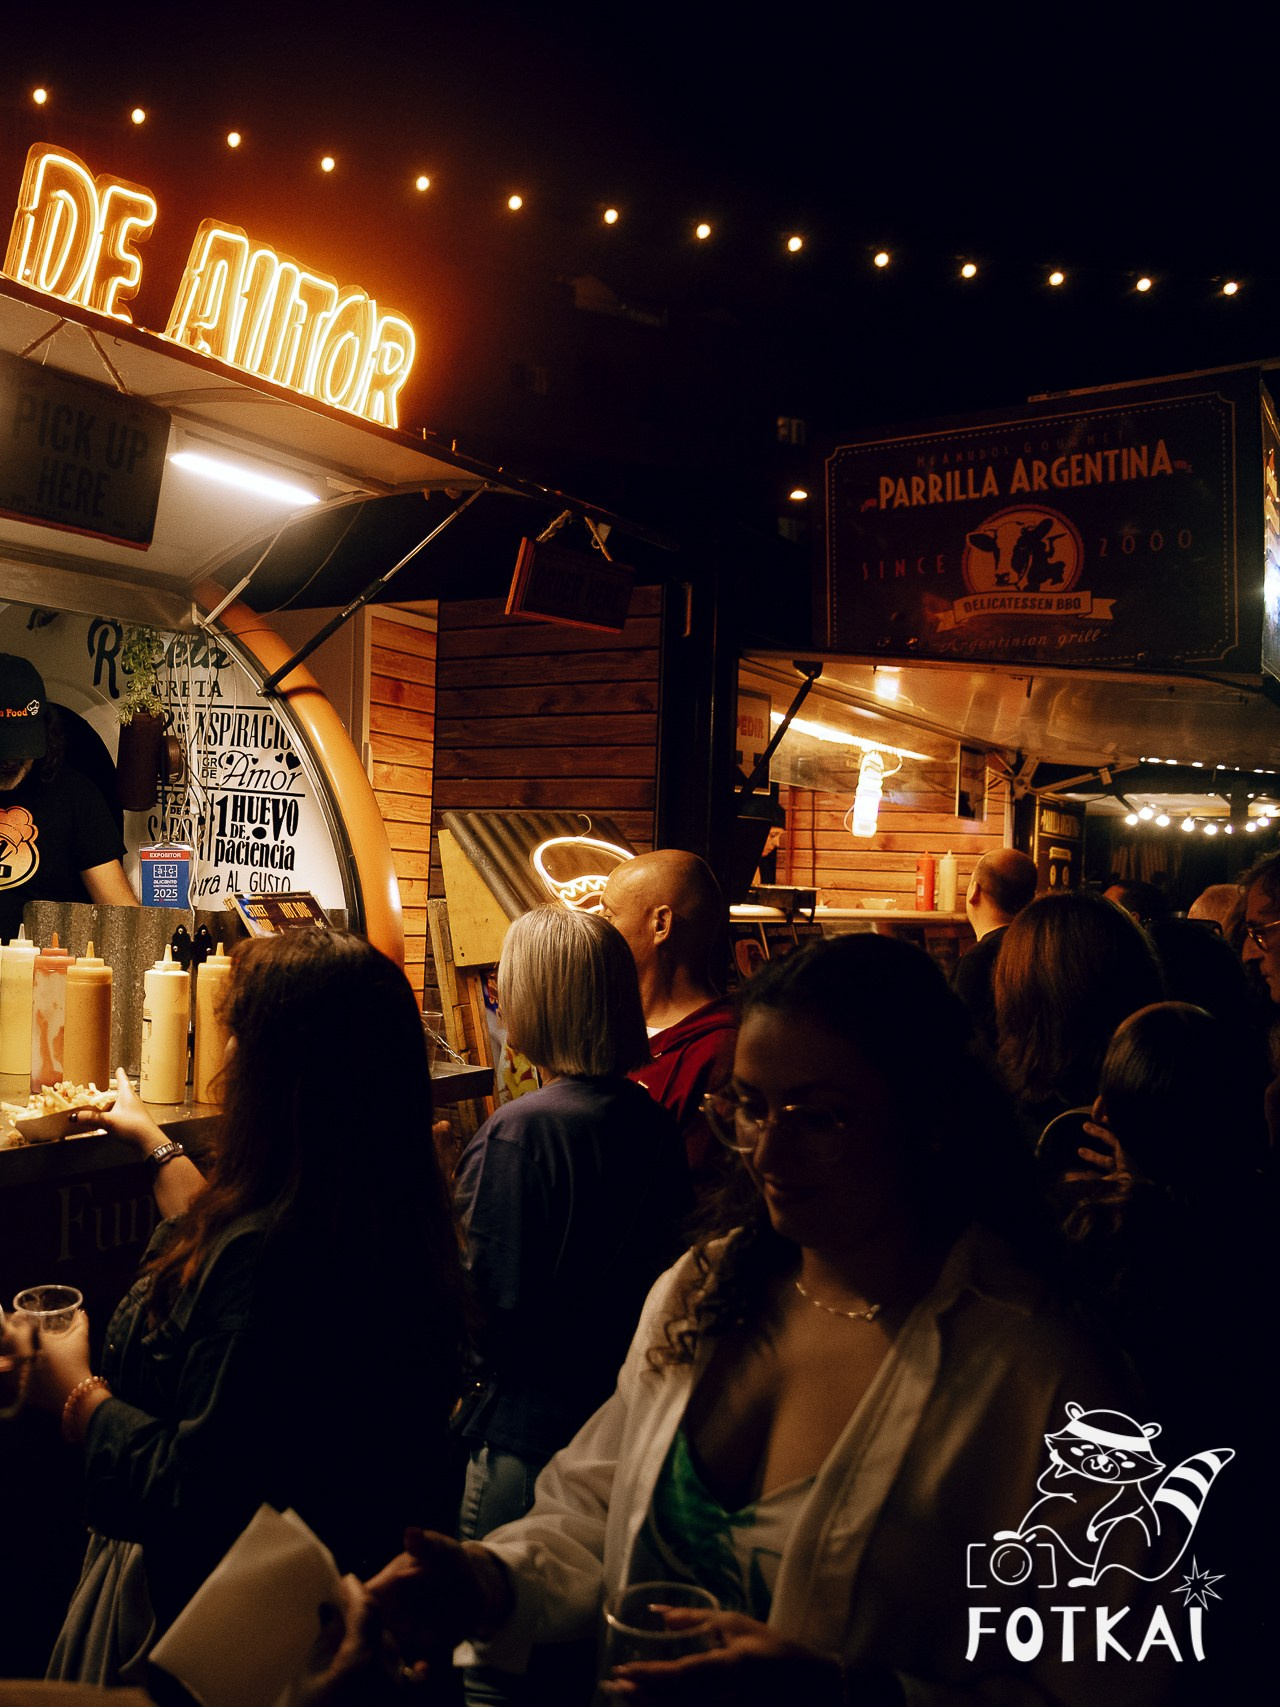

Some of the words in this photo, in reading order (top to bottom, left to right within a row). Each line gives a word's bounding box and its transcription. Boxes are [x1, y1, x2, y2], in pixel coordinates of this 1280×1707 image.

[8, 148, 158, 324] DE
[13, 393, 97, 460] PICK
[106, 421, 149, 474] UP
[36, 456, 111, 518] HERE
[877, 464, 1000, 512] PARRILLA
[1009, 437, 1175, 496] ARGENTINA
[861, 554, 945, 581] SINCE
[1098, 528, 1194, 558] 2000
[963, 597, 1053, 613] DELICATESSEN
[1056, 597, 1081, 610] BBQ
[6, 706, 29, 718] Food
[202, 769, 217, 779] DE
[216, 750, 303, 791] Amor
[231, 794, 299, 842] HUEVO
[214, 836, 295, 871] paciencia
[153, 888, 178, 898] 2025
[226, 870, 241, 892] AL
[277, 903, 297, 919] HOT
[292, 901, 313, 918] DOG
[56, 1181, 156, 1264] Fun
